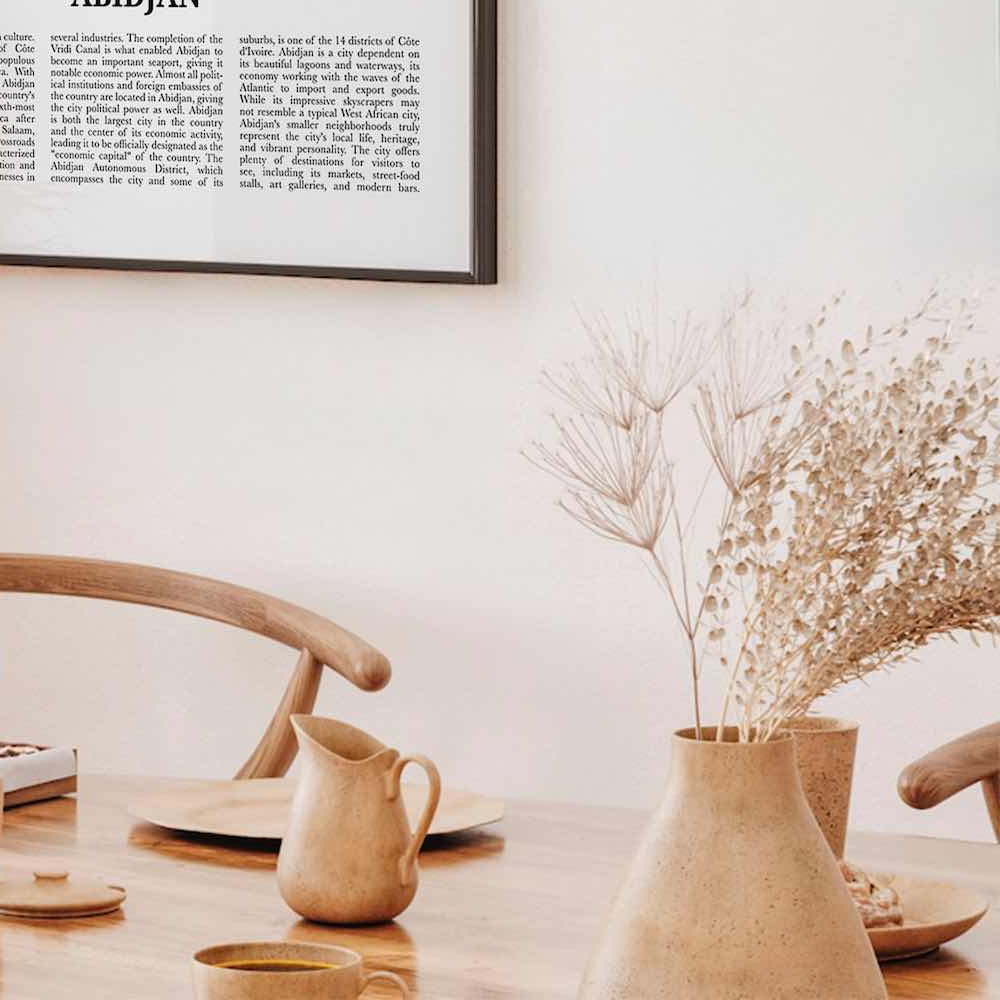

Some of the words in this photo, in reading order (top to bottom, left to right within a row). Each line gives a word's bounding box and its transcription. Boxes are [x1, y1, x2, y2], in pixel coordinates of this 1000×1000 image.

[3, 31, 35, 41] culture.
[50, 31, 79, 42] several
[81, 32, 124, 42] industries.
[126, 32, 144, 42] The
[146, 32, 194, 46] completion
[196, 33, 207, 43] of
[209, 33, 223, 43] the
[239, 33, 276, 45] suburbs,
[277, 34, 285, 44] is
[305, 34, 316, 44] of
[318, 34, 332, 44] the
[336, 34, 346, 44] 14
[347, 34, 383, 45] districts
[384, 35, 395, 45] of
[398, 35, 420, 45] Côte
[50, 55, 83, 65] become
[101, 56, 144, 69] important
[147, 57, 182, 69] seaport,
[186, 57, 213, 70] giving
[216, 58, 223, 67] it
[239, 58, 250, 67] its
[253, 57, 292, 68] beautiful
[296, 58, 331, 71] lagoons
[334, 58, 352, 69] and
[355, 59, 405, 72] waterways,
[409, 60, 420, 70] its
[1, 77, 35, 91] Abidjan
[50, 78, 65, 88] ical
[68, 79, 114, 89] institutions
[116, 79, 133, 89] and
[135, 79, 165, 93] foreign
[168, 80, 210, 91] embassies
[212, 81, 223, 91] of
[239, 81, 274, 92] Atlantic
[280, 83, 290, 92] to
[296, 83, 326, 95] import
[332, 82, 349, 93] and
[355, 84, 385, 96] export
[391, 83, 420, 97] goods.
[50, 102, 64, 112] the
[67, 103, 83, 115] city
[85, 102, 120, 116] political
[123, 106, 149, 116] power
[165, 104, 185, 114] well.
[188, 104, 223, 118] Abidjan
[239, 106, 254, 115] not
[257, 105, 296, 116] resemble
[307, 106, 337, 120] typical
[340, 107, 362, 117] West
[365, 107, 398, 118] African
[401, 109, 420, 121] city,
[1, 124, 35, 136] Salaam,
[50, 125, 67, 135] and
[70, 125, 84, 136] the
[87, 127, 114, 136] center
[117, 126, 128, 137] of
[131, 128, 142, 137] its
[145, 128, 186, 138] economic
[190, 129, 223, 142] activity,
[239, 130, 280, 143] represent
[285, 130, 299, 140] the
[304, 130, 327, 144] city's
[332, 131, 353, 141] local
[359, 131, 378, 144] life,
[380, 132, 420, 146] heritage,
[50, 148, 95, 159] "economic
[98, 150, 131, 163] capital"
[135, 150, 145, 161] of
[149, 151, 163, 161] the
[166, 152, 201, 165] country.
[204, 152, 223, 162] The
[239, 153, 267, 166] plenty
[273, 154, 284, 164] of
[291, 154, 344, 165] destinations
[351, 155, 364, 166] for
[371, 157, 404, 167] visitors
[410, 158, 420, 167] to
[26, 172, 35, 181] in
[50, 175, 104, 186] encompasses
[109, 173, 122, 184] the
[127, 175, 143, 187] city
[148, 174, 165, 185] and
[197, 176, 208, 186] of
[213, 177, 223, 186] its
[239, 177, 263, 189] stalls,
[269, 178, 282, 188] art
[288, 178, 327, 192] galleries,
[333, 179, 350, 190] and
[356, 180, 391, 191] modern
[398, 181, 420, 192] bars.
